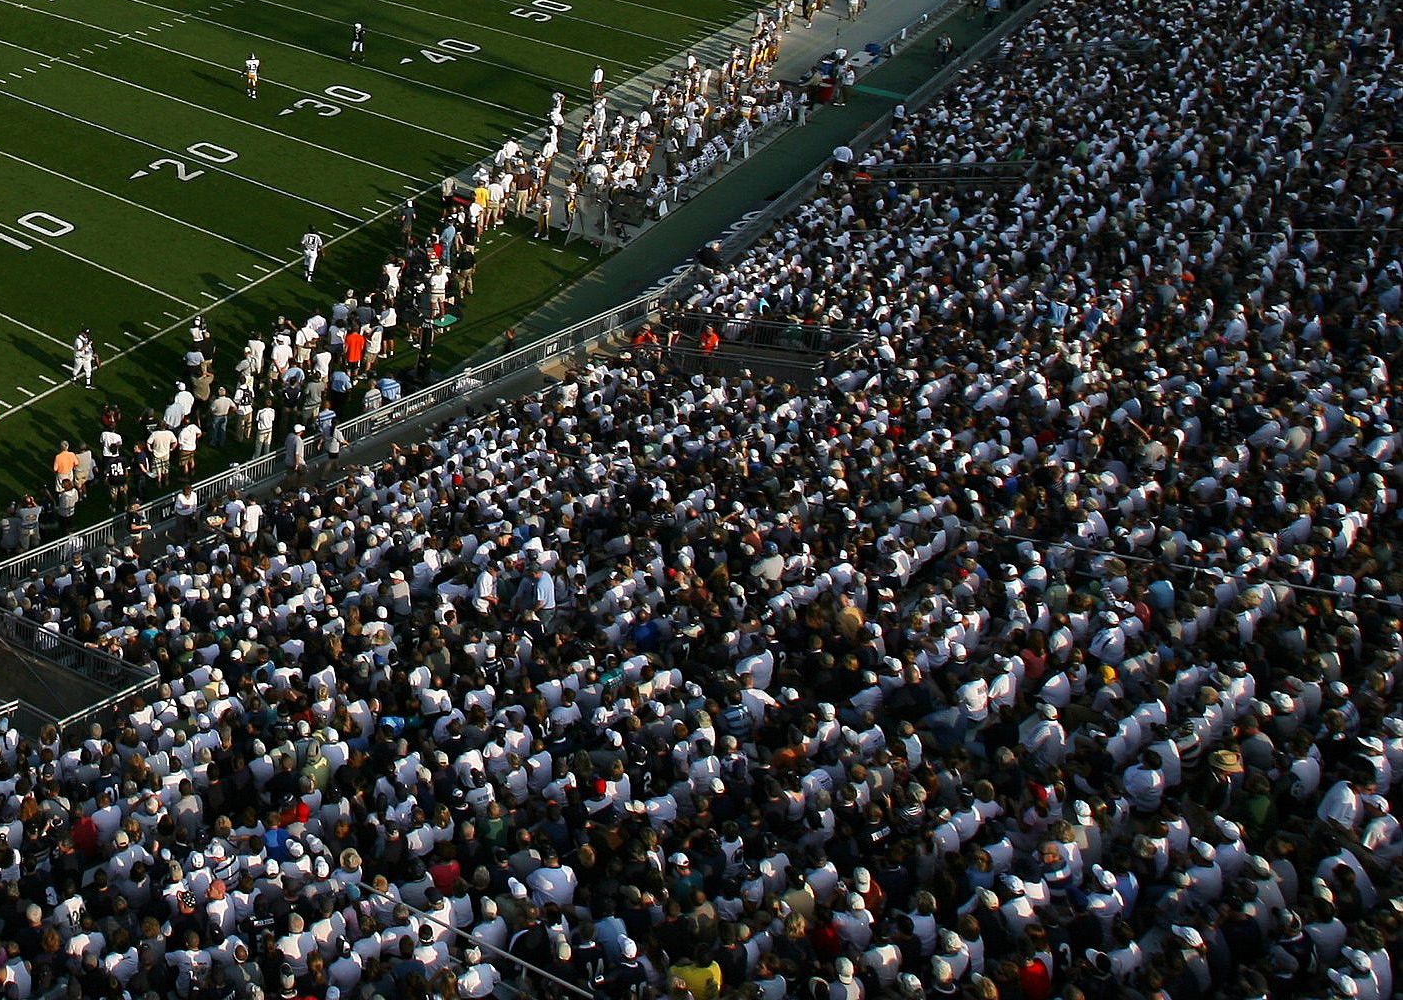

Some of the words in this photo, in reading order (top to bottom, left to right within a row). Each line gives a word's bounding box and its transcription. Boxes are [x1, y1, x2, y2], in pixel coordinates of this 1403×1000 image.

[419, 37, 482, 66] 40
[293, 84, 373, 118] 30
[147, 141, 241, 183] 20
[110, 462, 124, 476] 24
